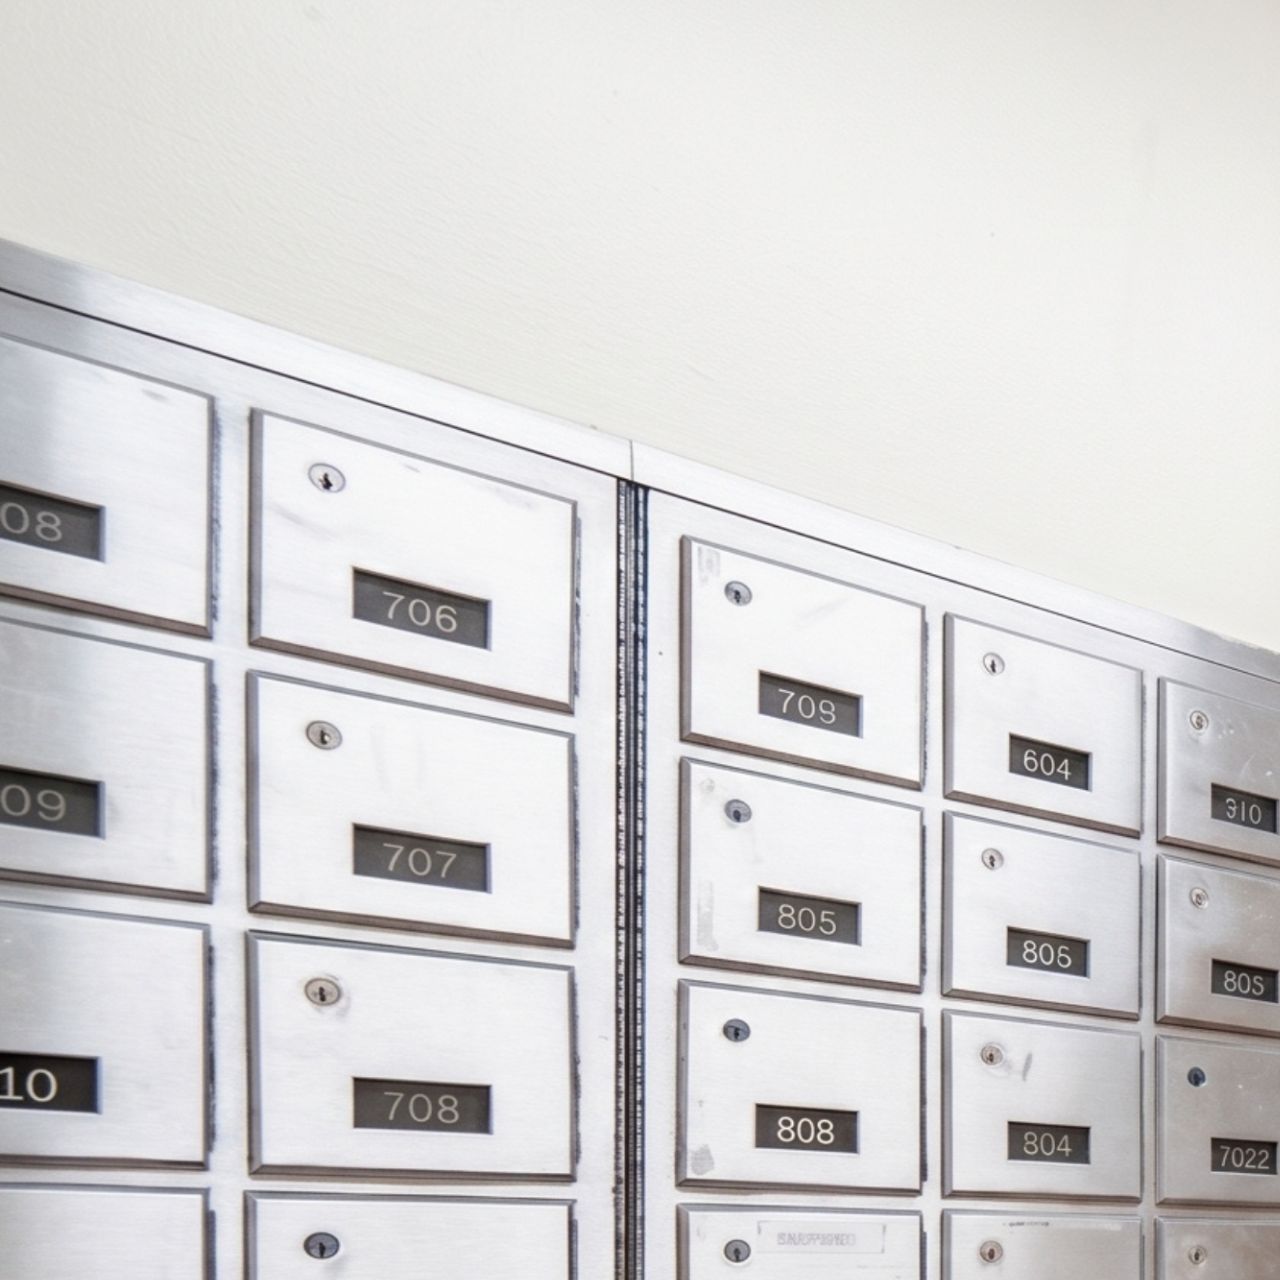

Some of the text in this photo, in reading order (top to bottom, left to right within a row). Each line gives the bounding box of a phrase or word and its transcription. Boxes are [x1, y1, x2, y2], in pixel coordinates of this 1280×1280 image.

[382, 591, 458, 634] 706
[1023, 748, 1072, 782] 604
[382, 842, 457, 879] 707
[778, 904, 837, 936] 805
[383, 1091, 459, 1124] 708
[777, 1116, 835, 1145] 808
[1023, 1131, 1072, 1158] 804
[1219, 1146, 1270, 1170] 7022
